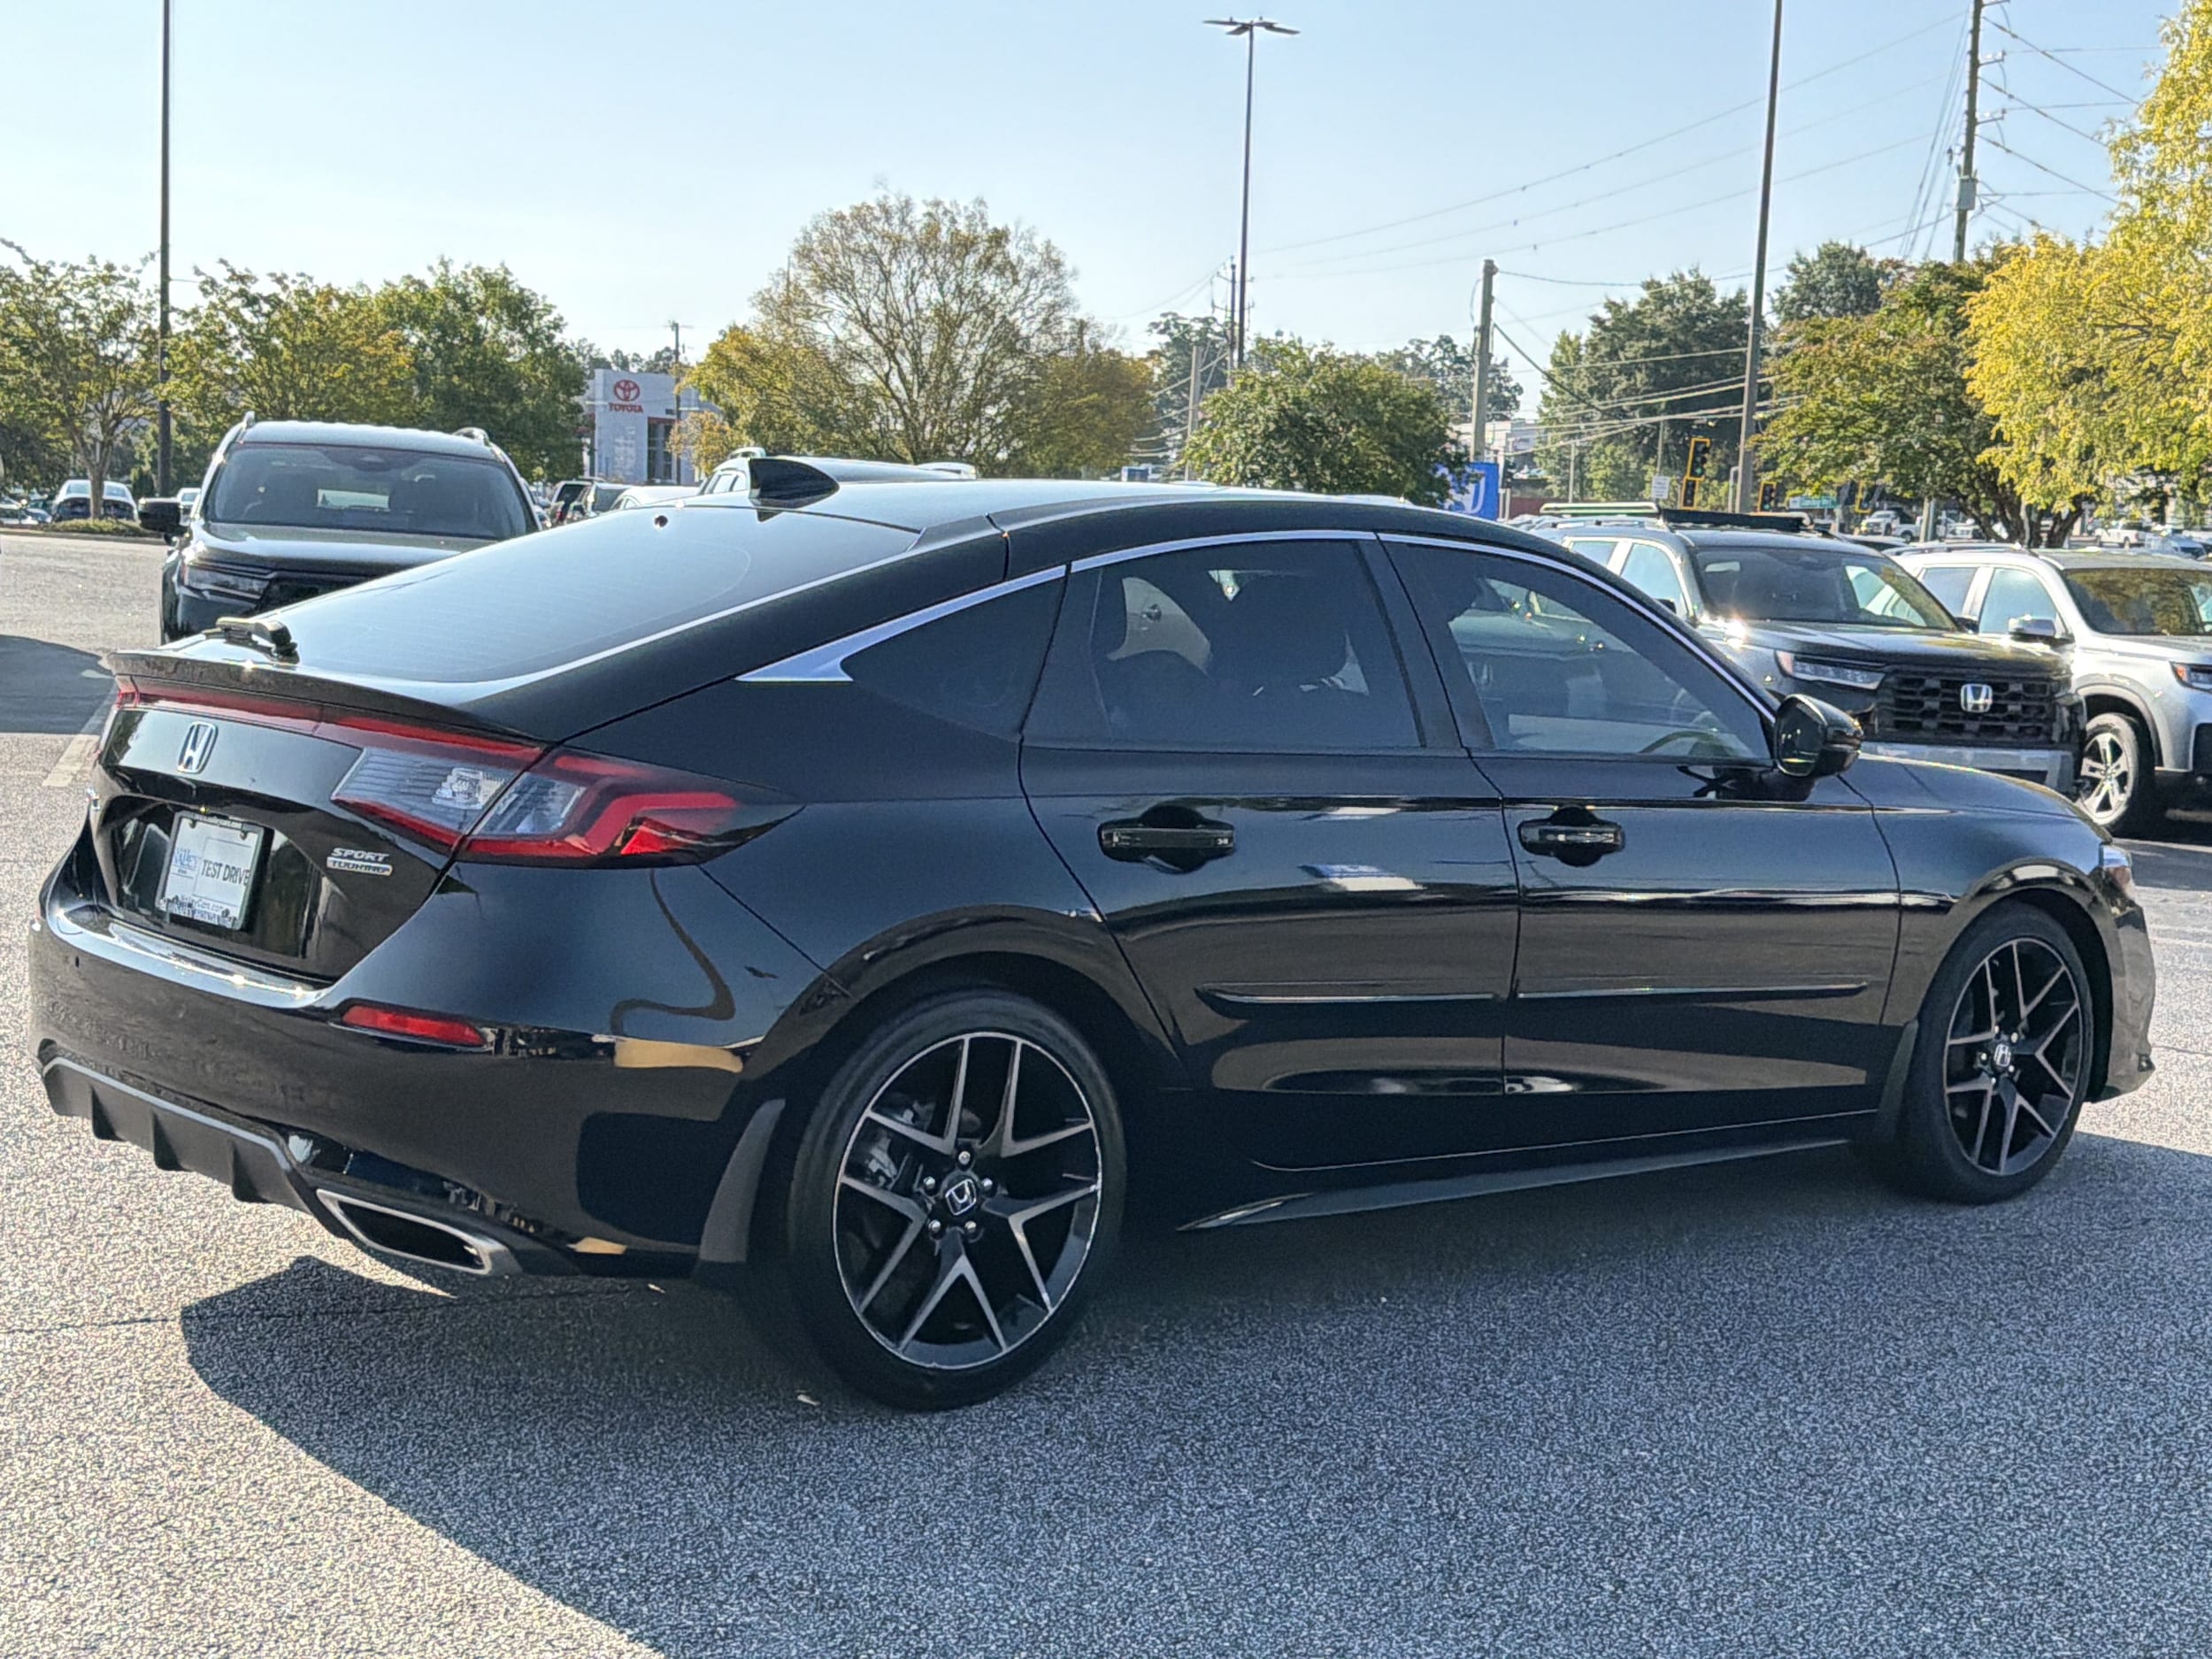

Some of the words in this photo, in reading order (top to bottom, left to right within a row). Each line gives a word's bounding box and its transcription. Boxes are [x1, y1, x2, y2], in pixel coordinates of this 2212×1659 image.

[608, 403, 643, 413] TOYOTA
[331, 848, 389, 862] SPORT
[202, 859, 224, 879] TEST
[222, 864, 250, 885] DRIVE
